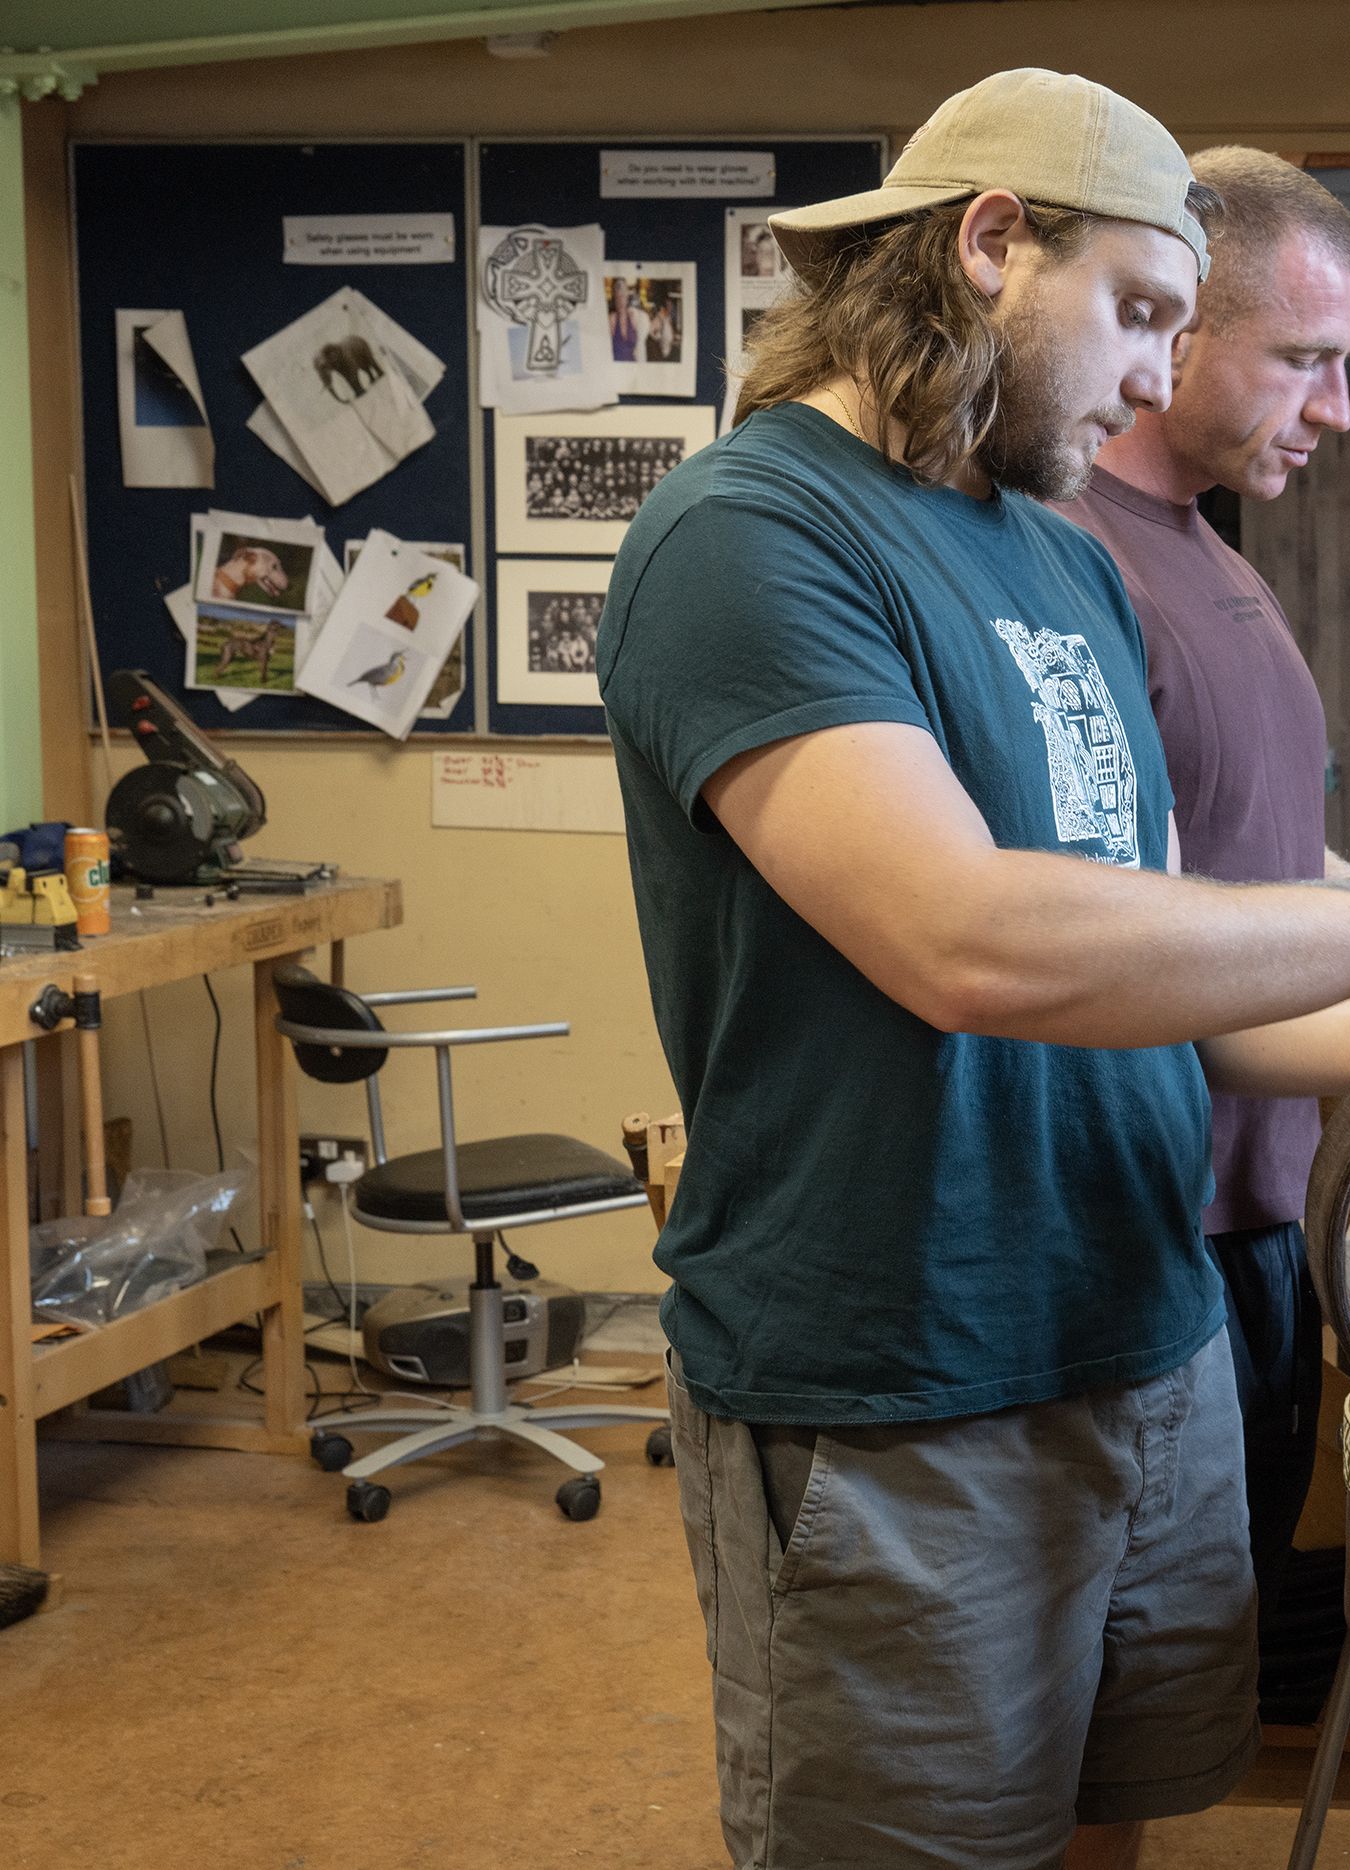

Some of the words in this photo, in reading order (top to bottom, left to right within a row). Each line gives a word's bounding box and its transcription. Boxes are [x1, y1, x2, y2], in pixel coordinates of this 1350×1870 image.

[679, 177, 696, 186] with
[306, 232, 333, 245] Safety
[335, 233, 369, 245] glasses
[371, 232, 393, 241] must
[395, 231, 408, 240] be
